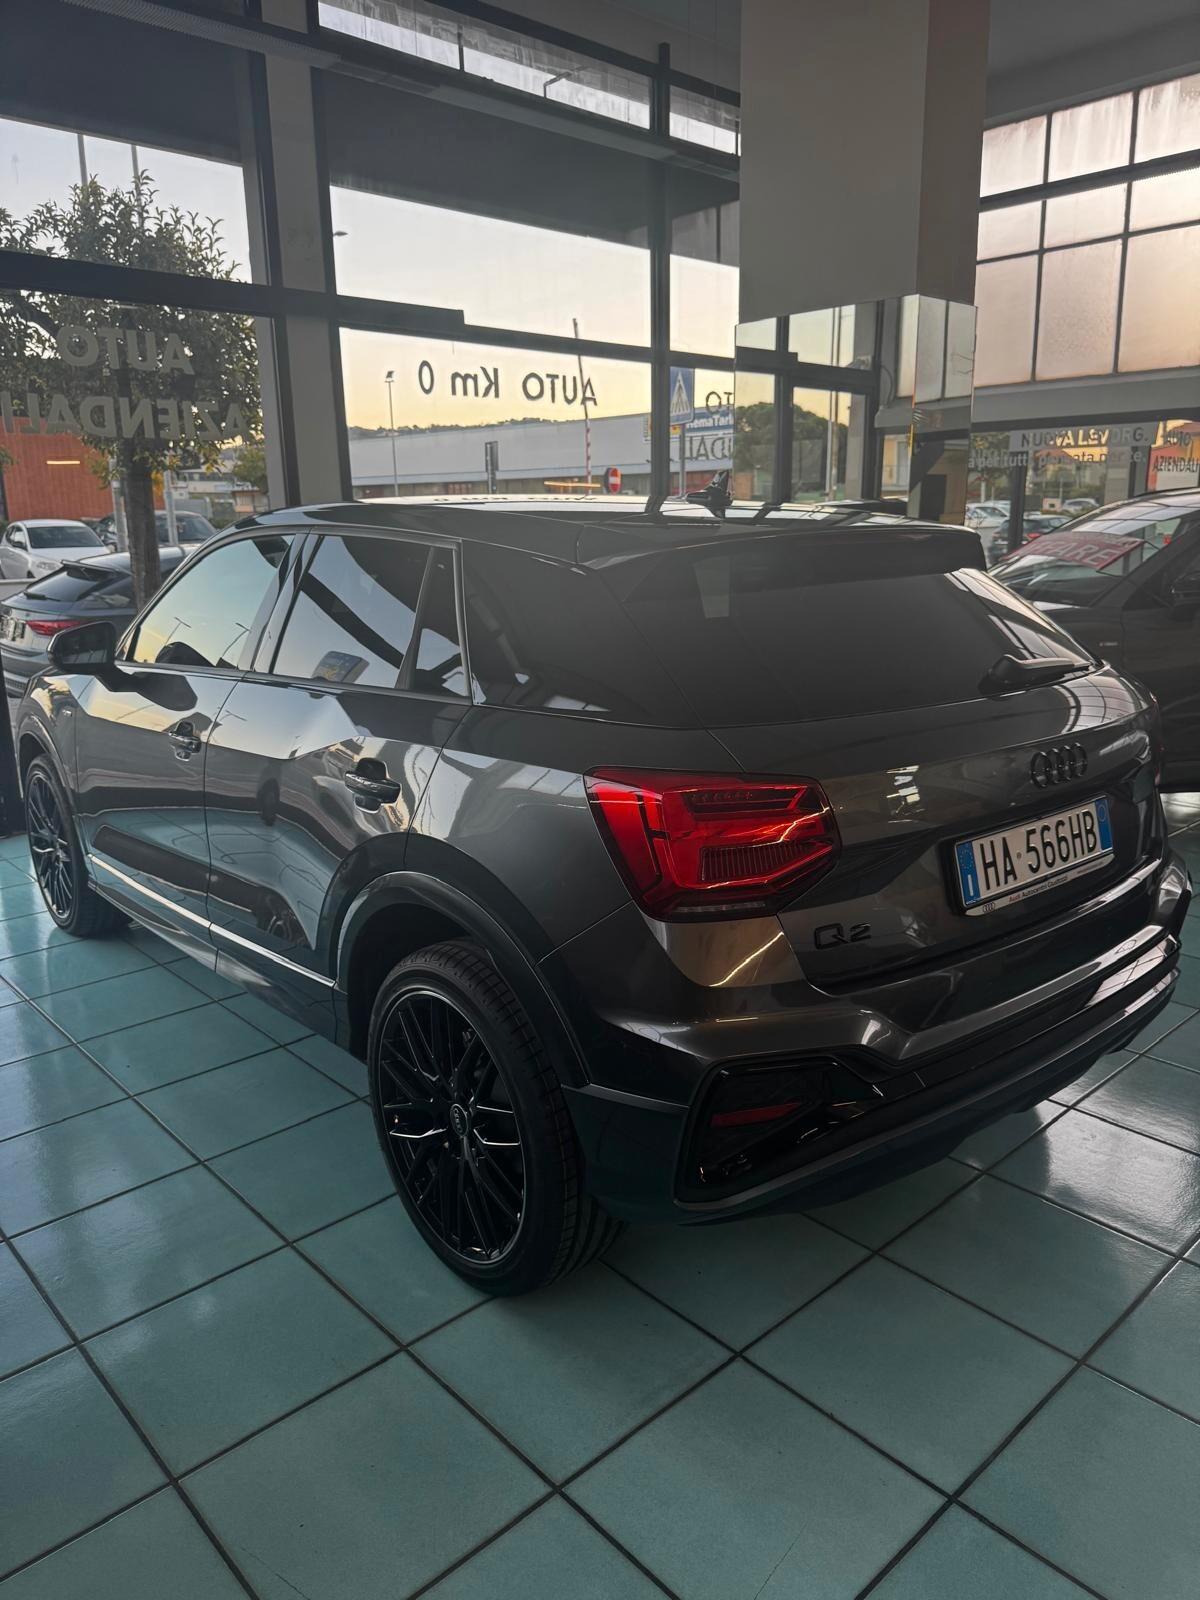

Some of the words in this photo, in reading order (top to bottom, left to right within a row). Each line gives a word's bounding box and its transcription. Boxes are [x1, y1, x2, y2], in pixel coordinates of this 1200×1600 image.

[1003, 452, 1031, 468] tutt
[980, 836, 1017, 891] HA
[1025, 809, 1097, 874] 566HB
[814, 923, 872, 950] Q2
